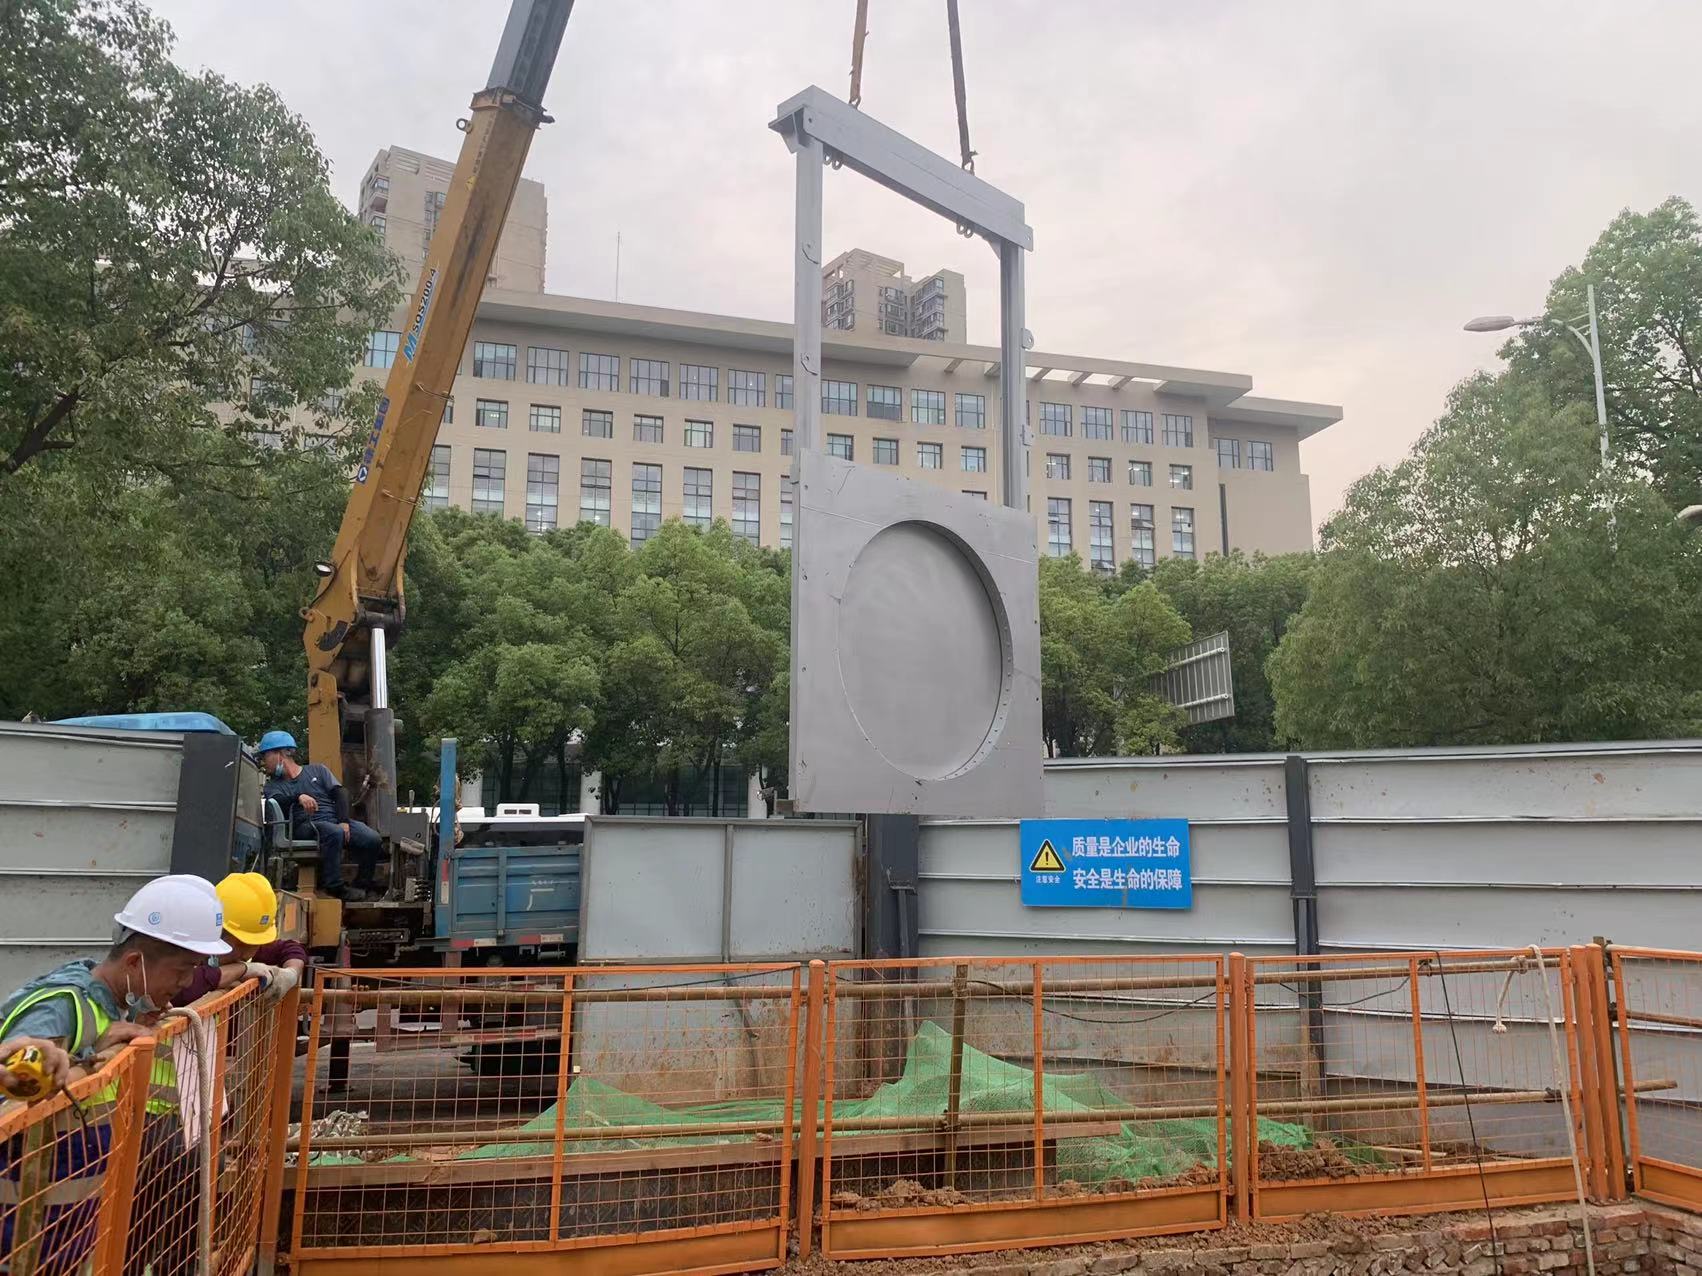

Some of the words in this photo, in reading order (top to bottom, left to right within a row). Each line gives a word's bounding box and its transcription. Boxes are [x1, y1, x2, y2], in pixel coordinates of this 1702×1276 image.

[1072, 836, 1180, 858] 质量是企业的生命
[1073, 868, 1183, 890] 安全是生命的保障
